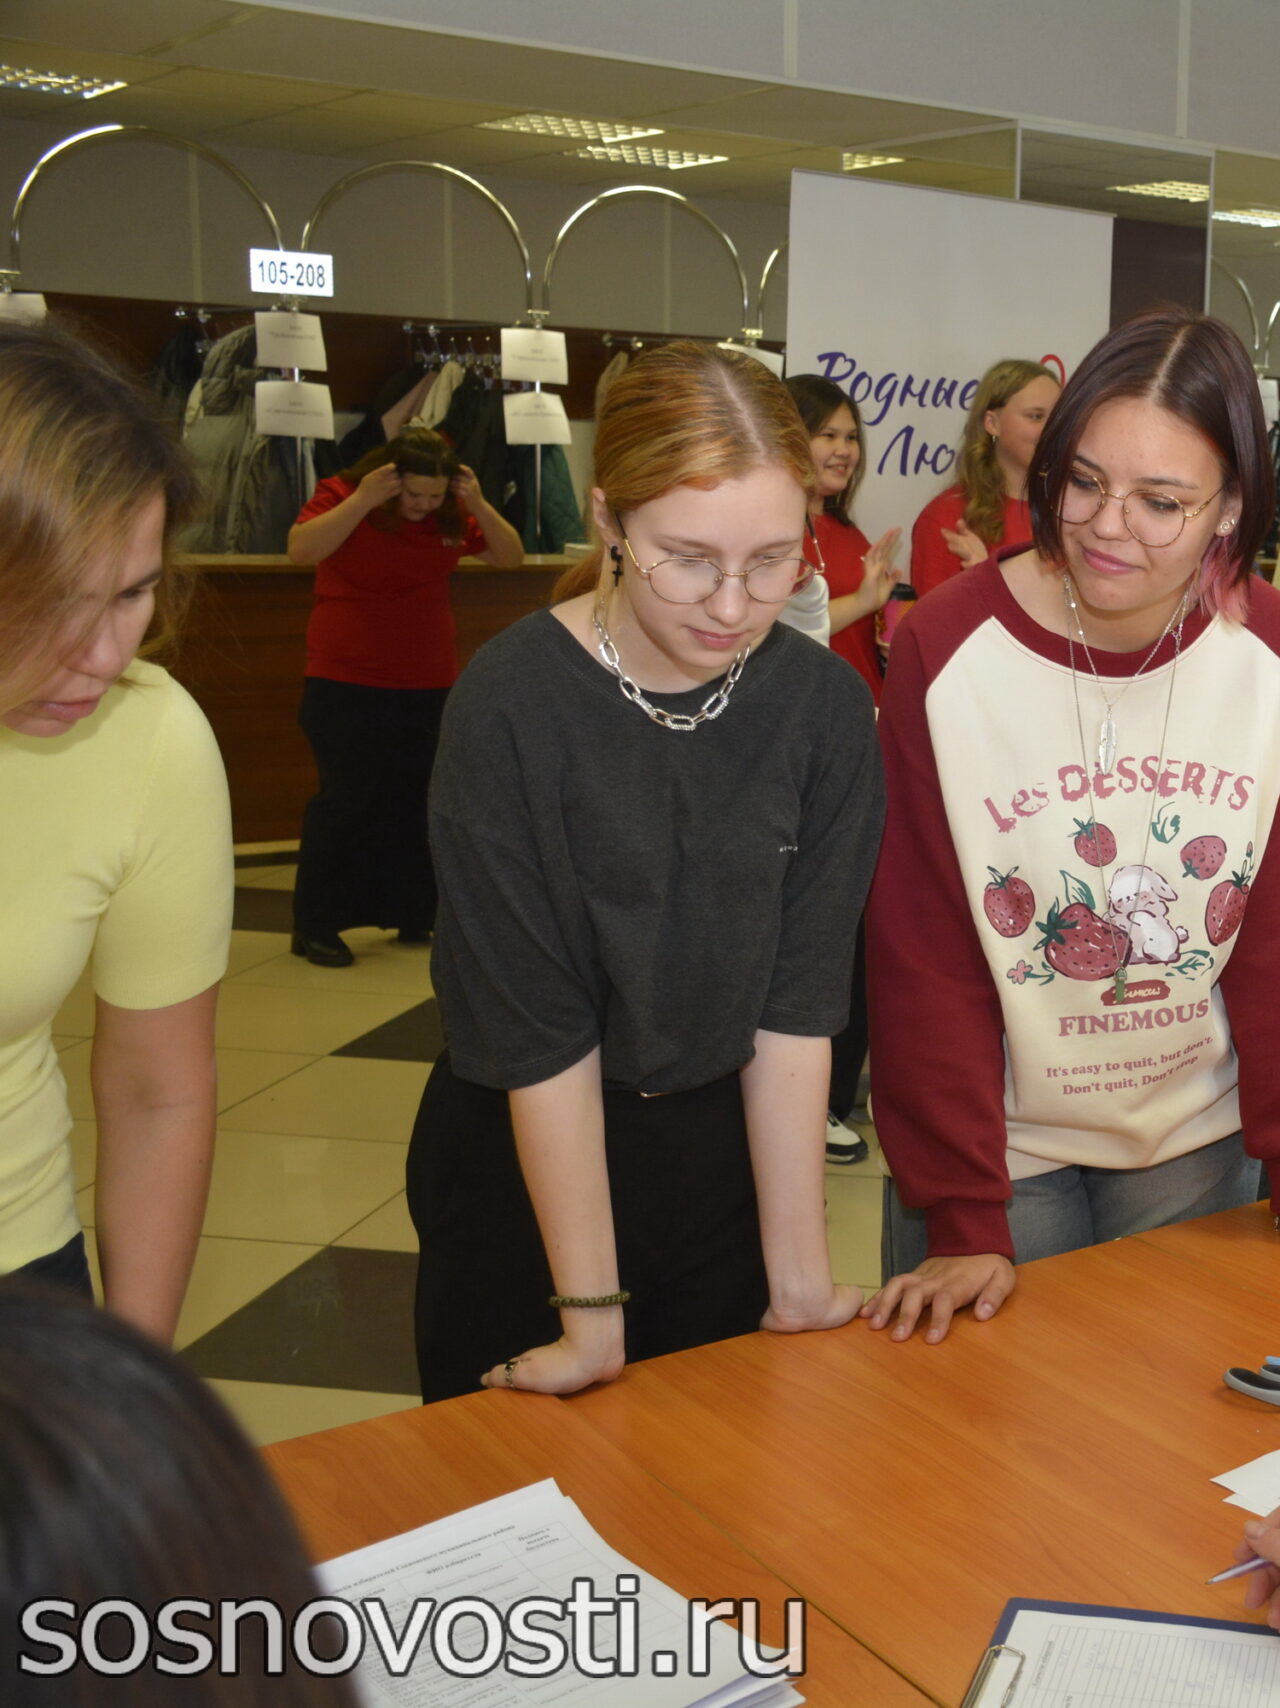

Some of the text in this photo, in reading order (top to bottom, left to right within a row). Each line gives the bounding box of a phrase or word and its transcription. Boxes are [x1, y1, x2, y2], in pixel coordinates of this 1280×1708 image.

[258, 260, 326, 288] 105-208
[817, 351, 980, 427] Родные
[983, 756, 1255, 833] Les DESSERTS
[1058, 998, 1209, 1037] FINEMOUS
[1046, 1067, 1069, 1078] It's
[1072, 1064, 1102, 1076] easy
[1105, 1061, 1120, 1071] to
[1124, 1056, 1157, 1073] quit,
[1160, 1050, 1182, 1063] but
[1062, 1081, 1101, 1095] Don't
[1104, 1077, 1139, 1093] quit,
[1141, 1067, 1175, 1086] Don't
